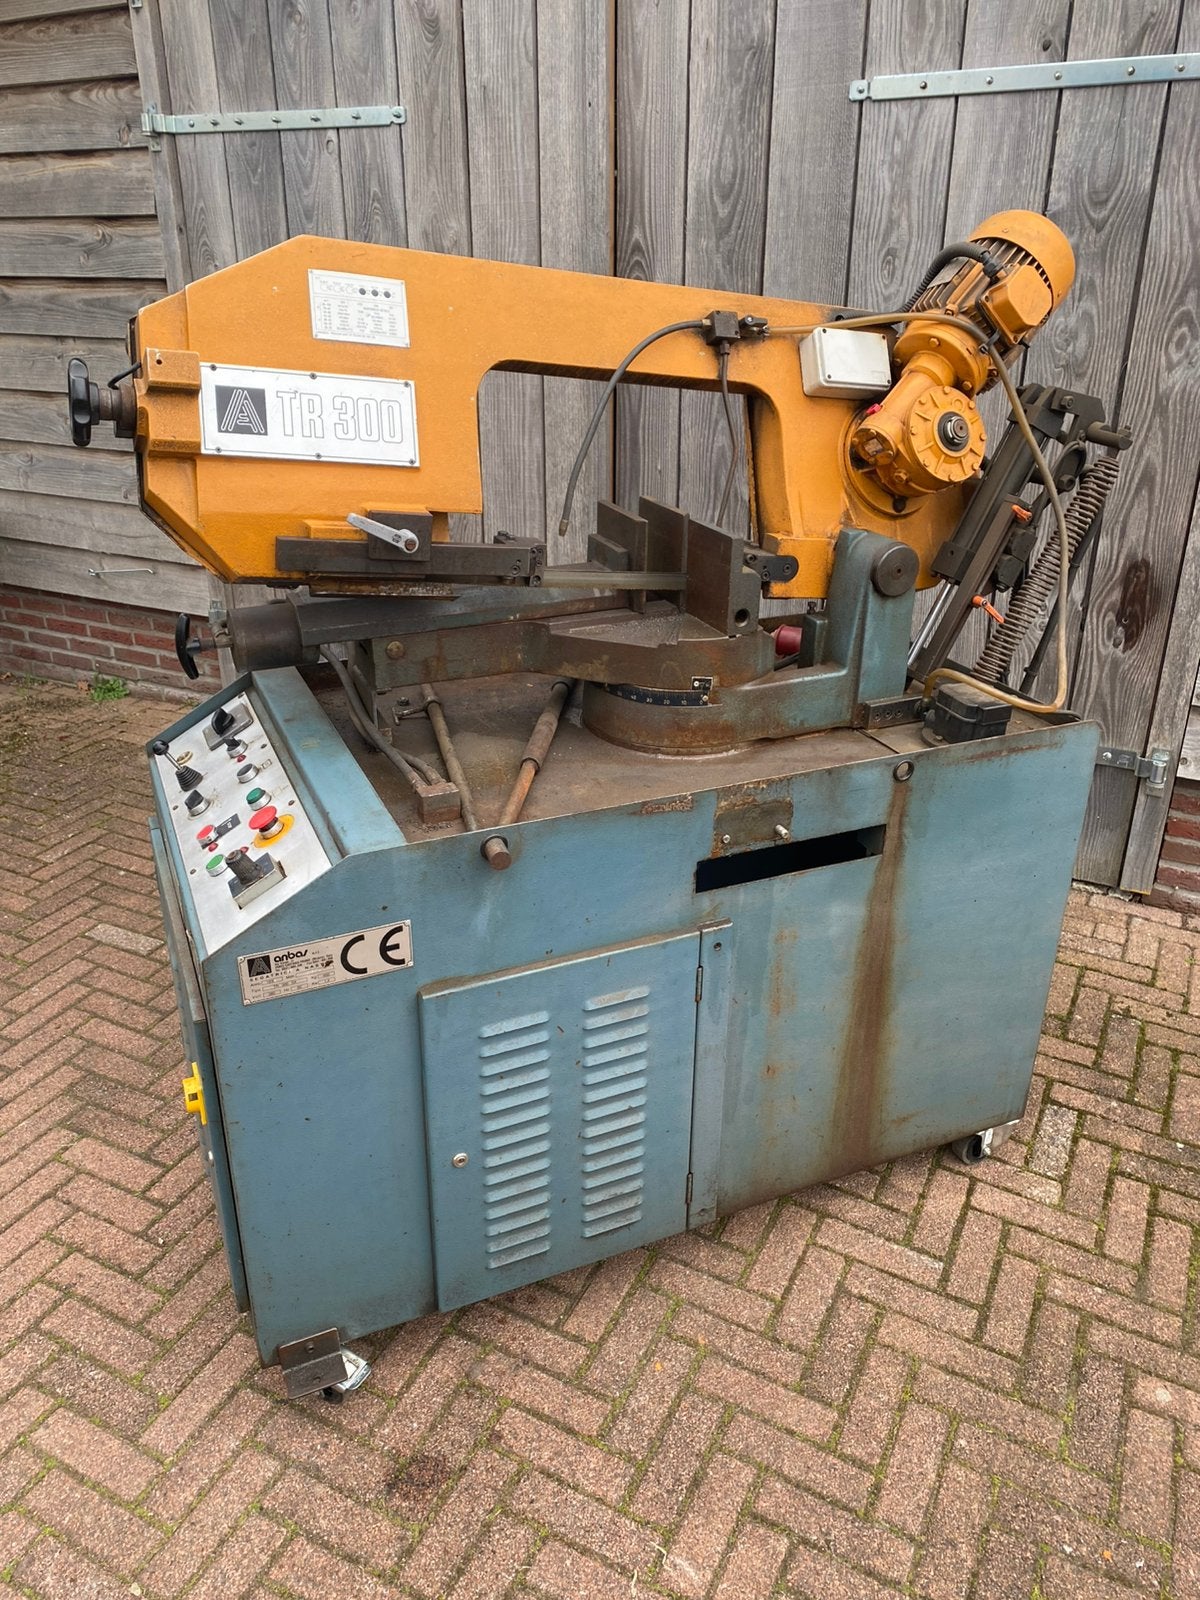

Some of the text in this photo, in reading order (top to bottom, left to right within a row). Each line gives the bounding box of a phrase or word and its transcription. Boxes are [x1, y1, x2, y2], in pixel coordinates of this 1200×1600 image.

[276, 390, 325, 439] TR
[332, 395, 404, 444] 300
[274, 949, 308, 963] anbas
[341, 925, 406, 975] CE
